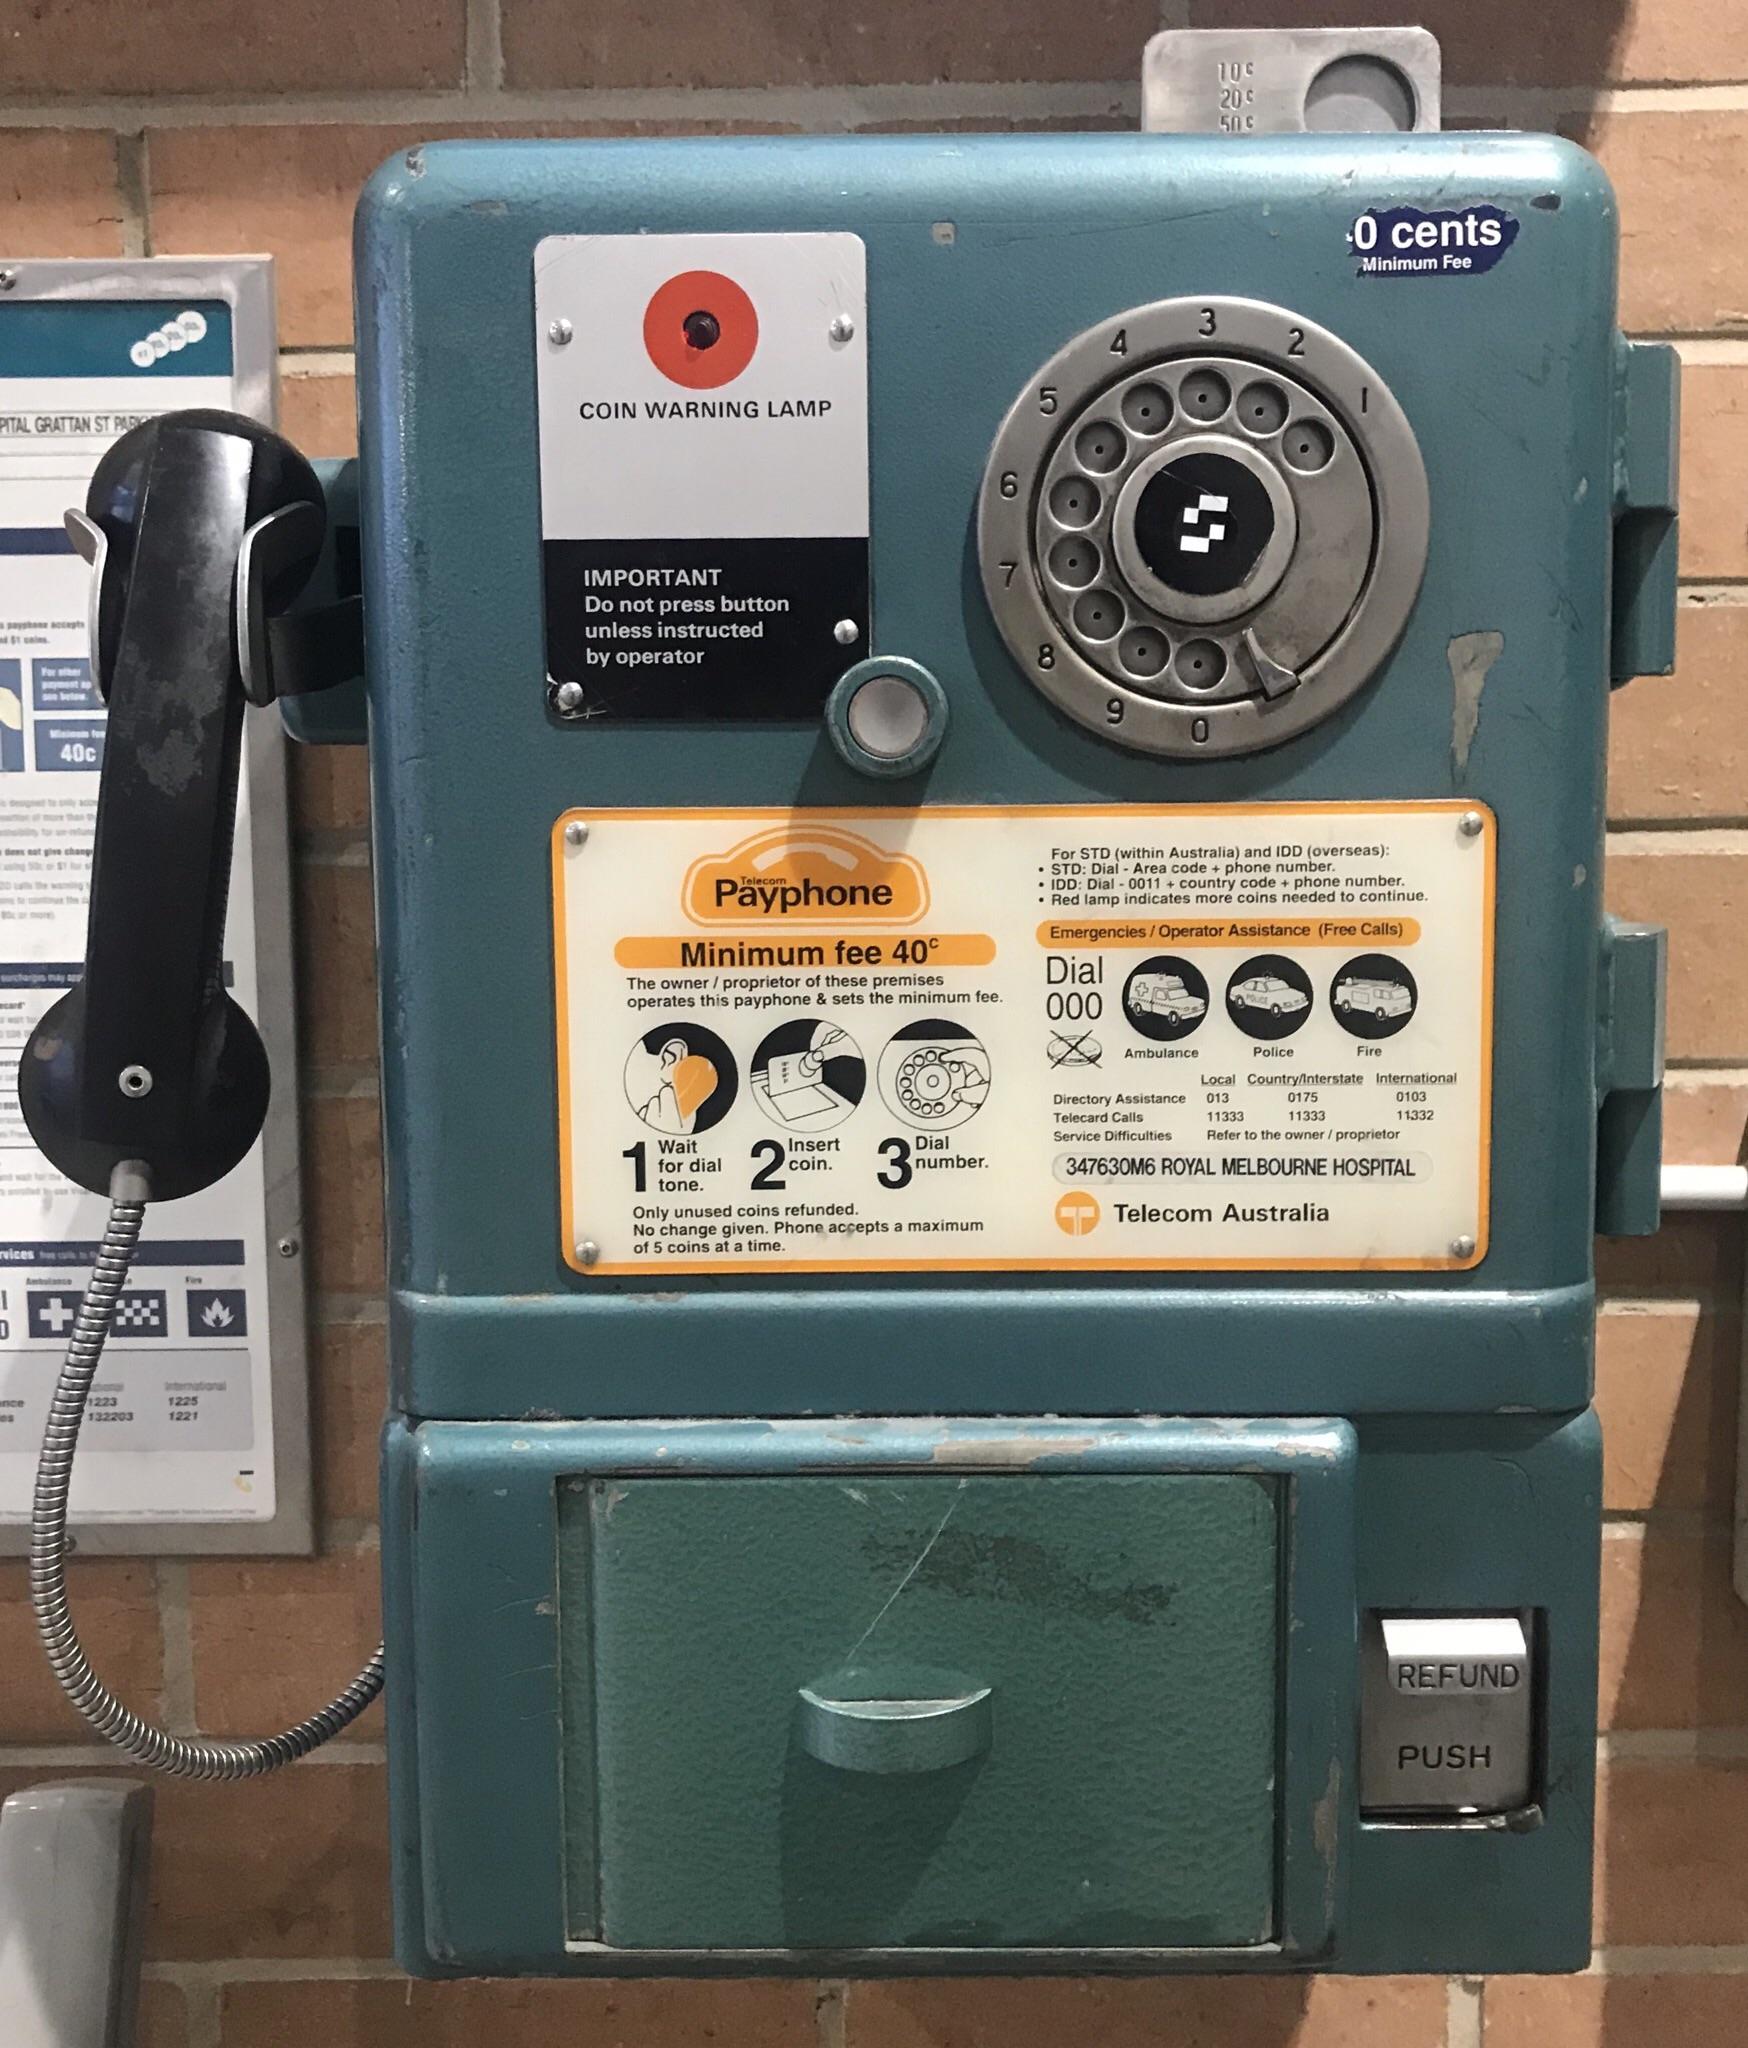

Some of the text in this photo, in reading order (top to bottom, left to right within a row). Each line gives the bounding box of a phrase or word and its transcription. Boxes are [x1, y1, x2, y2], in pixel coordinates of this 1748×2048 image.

[1391, 213, 1502, 249] cents
[1361, 253, 1472, 271] Minimum Fee
[1199, 308, 1216, 336] 3
[1110, 329, 1128, 356] 4
[1287, 329, 1305, 356] 2
[579, 399, 831, 420] COIN WARNING LAMP
[1039, 387, 1057, 416] 5
[34, 416, 91, 433] GRATTAN
[94, 416, 110, 433] ST
[1001, 471, 1018, 498] 6
[584, 568, 722, 587] IMPORTANT
[1000, 562, 1017, 588] 7
[584, 594, 789, 616] Do not press button
[584, 620, 763, 639] unless instructed
[586, 647, 705, 668] by operator
[1038, 644, 1055, 670] 8
[1107, 698, 1123, 724] 9
[60, 743, 97, 763] 40c
[1051, 844, 1389, 862] For STD (within Australia) and IDD (overseas):
[1050, 860, 1335, 876] STD: Dial Area code phone number.
[741, 876, 786, 886] Telecom
[1050, 874, 1405, 892] IDD: Dial 0011 country code phone number.
[715, 879, 892, 913] Payphone
[1051, 889, 1427, 908] Red lamp indicates more coins needed to continue.
[1050, 921, 1403, 942] Emergencies Operator Assistance (Free Calls)
[680, 941, 824, 967] Minimum
[834, 939, 882, 965] fee
[1046, 955, 1103, 985] Dial
[625, 973, 944, 992] The owner proprietor of these premises
[626, 989, 1003, 1011] operates this payphone & sets the minimum fee.
[1046, 991, 1103, 1021] 000
[1123, 1047, 1199, 1059] Ambulance
[1253, 1046, 1294, 1058] Police
[1356, 1045, 1382, 1057] Fire
[1200, 1073, 1236, 1086] Local
[1246, 1072, 1364, 1087] Country/Interstate
[1375, 1072, 1457, 1085] International
[1053, 1093, 1186, 1108] Directory Assistance
[1206, 1091, 1229, 1104] 013
[1287, 1091, 1318, 1103] 0175
[1395, 1090, 1427, 1102] 0103
[1052, 1111, 1144, 1124] Telecard Calls
[1207, 1110, 1244, 1122] 11333
[1288, 1109, 1326, 1122] 11333
[1396, 1109, 1434, 1121] 11332
[915, 1134, 949, 1150] Dial
[1053, 1129, 1172, 1142] Service Difficulties
[1206, 1128, 1400, 1142] Refer to the owner proprietor
[657, 1138, 697, 1154] Wait
[788, 1137, 840, 1152] Insert
[622, 1140, 646, 1192] 1
[657, 1157, 721, 1173] for dial
[750, 1138, 786, 1190] 2
[788, 1155, 832, 1171] coin.
[876, 1137, 912, 1189] 3
[915, 1153, 988, 1169] number.
[1065, 1156, 1416, 1177] 347630M6 ROYAL MELBOURNE HOSPITAL
[657, 1178, 704, 1192] tone.
[632, 1202, 858, 1222] Only unused coins refunded.
[1113, 1202, 1329, 1223] Telecom Australia
[633, 1220, 983, 1239] No change given. Phone accepts a maximum
[633, 1238, 785, 1254] of 5 coins at a time.
[168, 1396, 199, 1407] 1225
[168, 1411, 199, 1421] 1221
[1398, 1664, 1519, 1688] REFUND
[1397, 1743, 1490, 1770] PUSH
